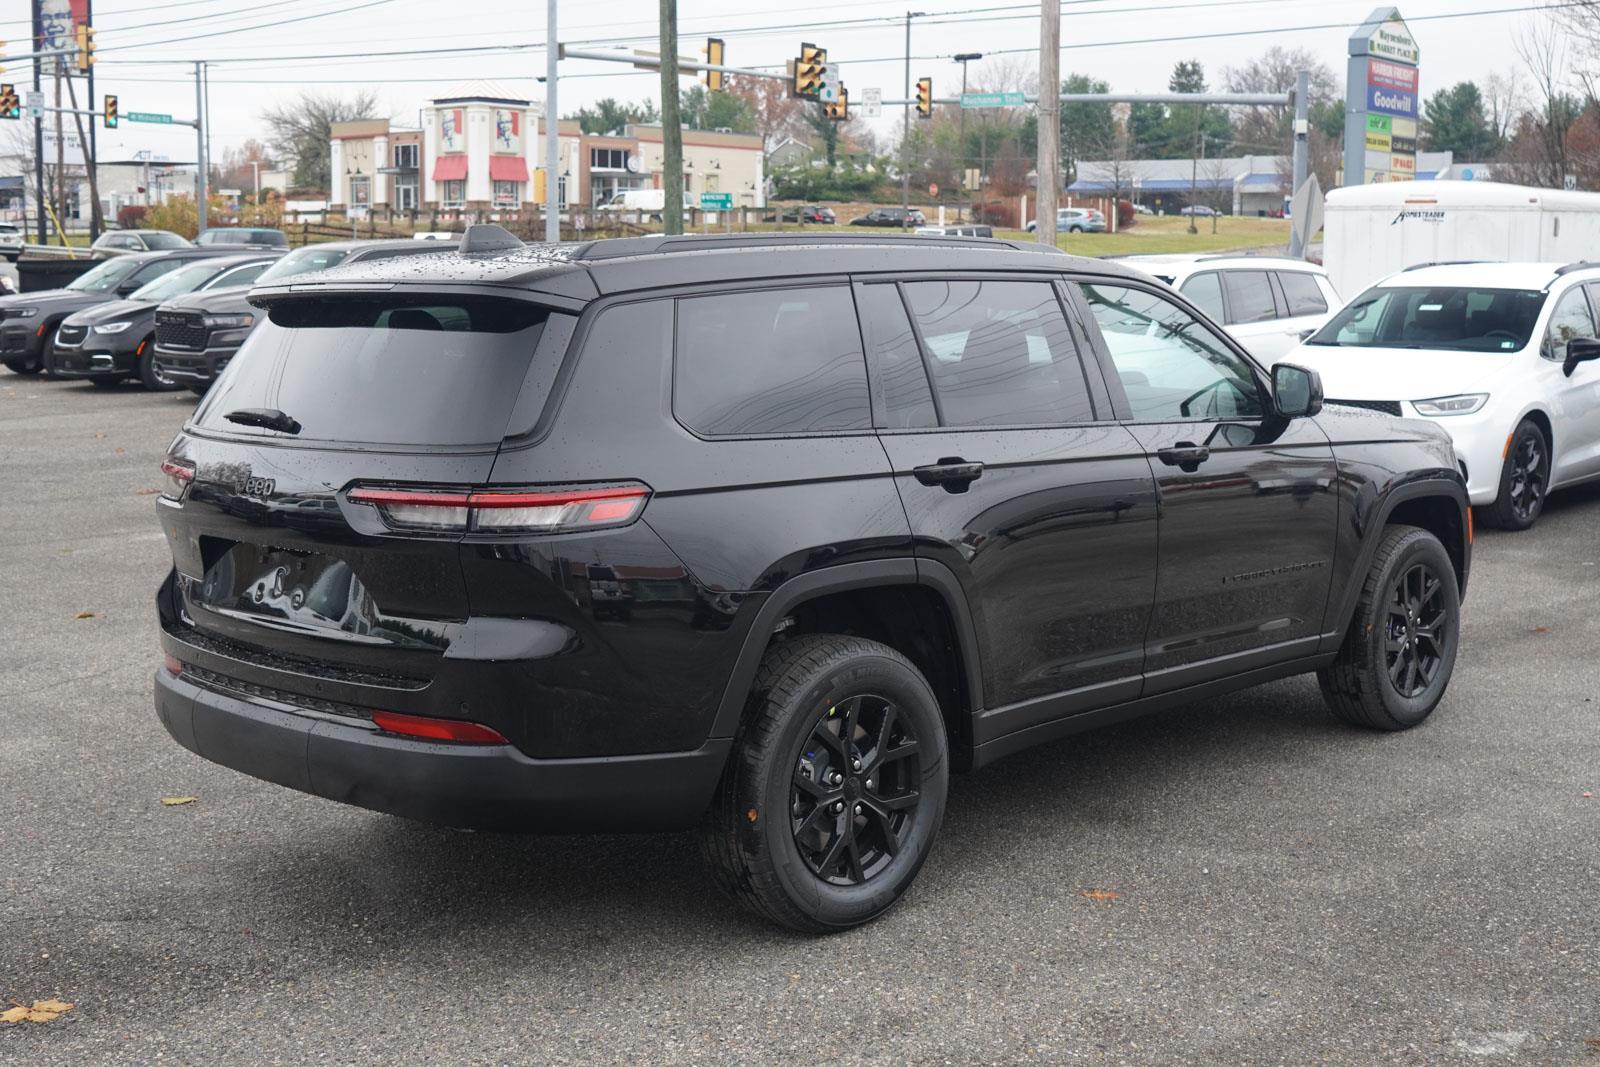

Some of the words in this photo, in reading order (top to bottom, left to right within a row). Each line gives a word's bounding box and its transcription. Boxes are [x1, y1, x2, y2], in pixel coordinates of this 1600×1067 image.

[1374, 91, 1412, 113] Goodwill
[1390, 210, 1445, 225] HOMESTEADER
[236, 470, 276, 500] Jeep
